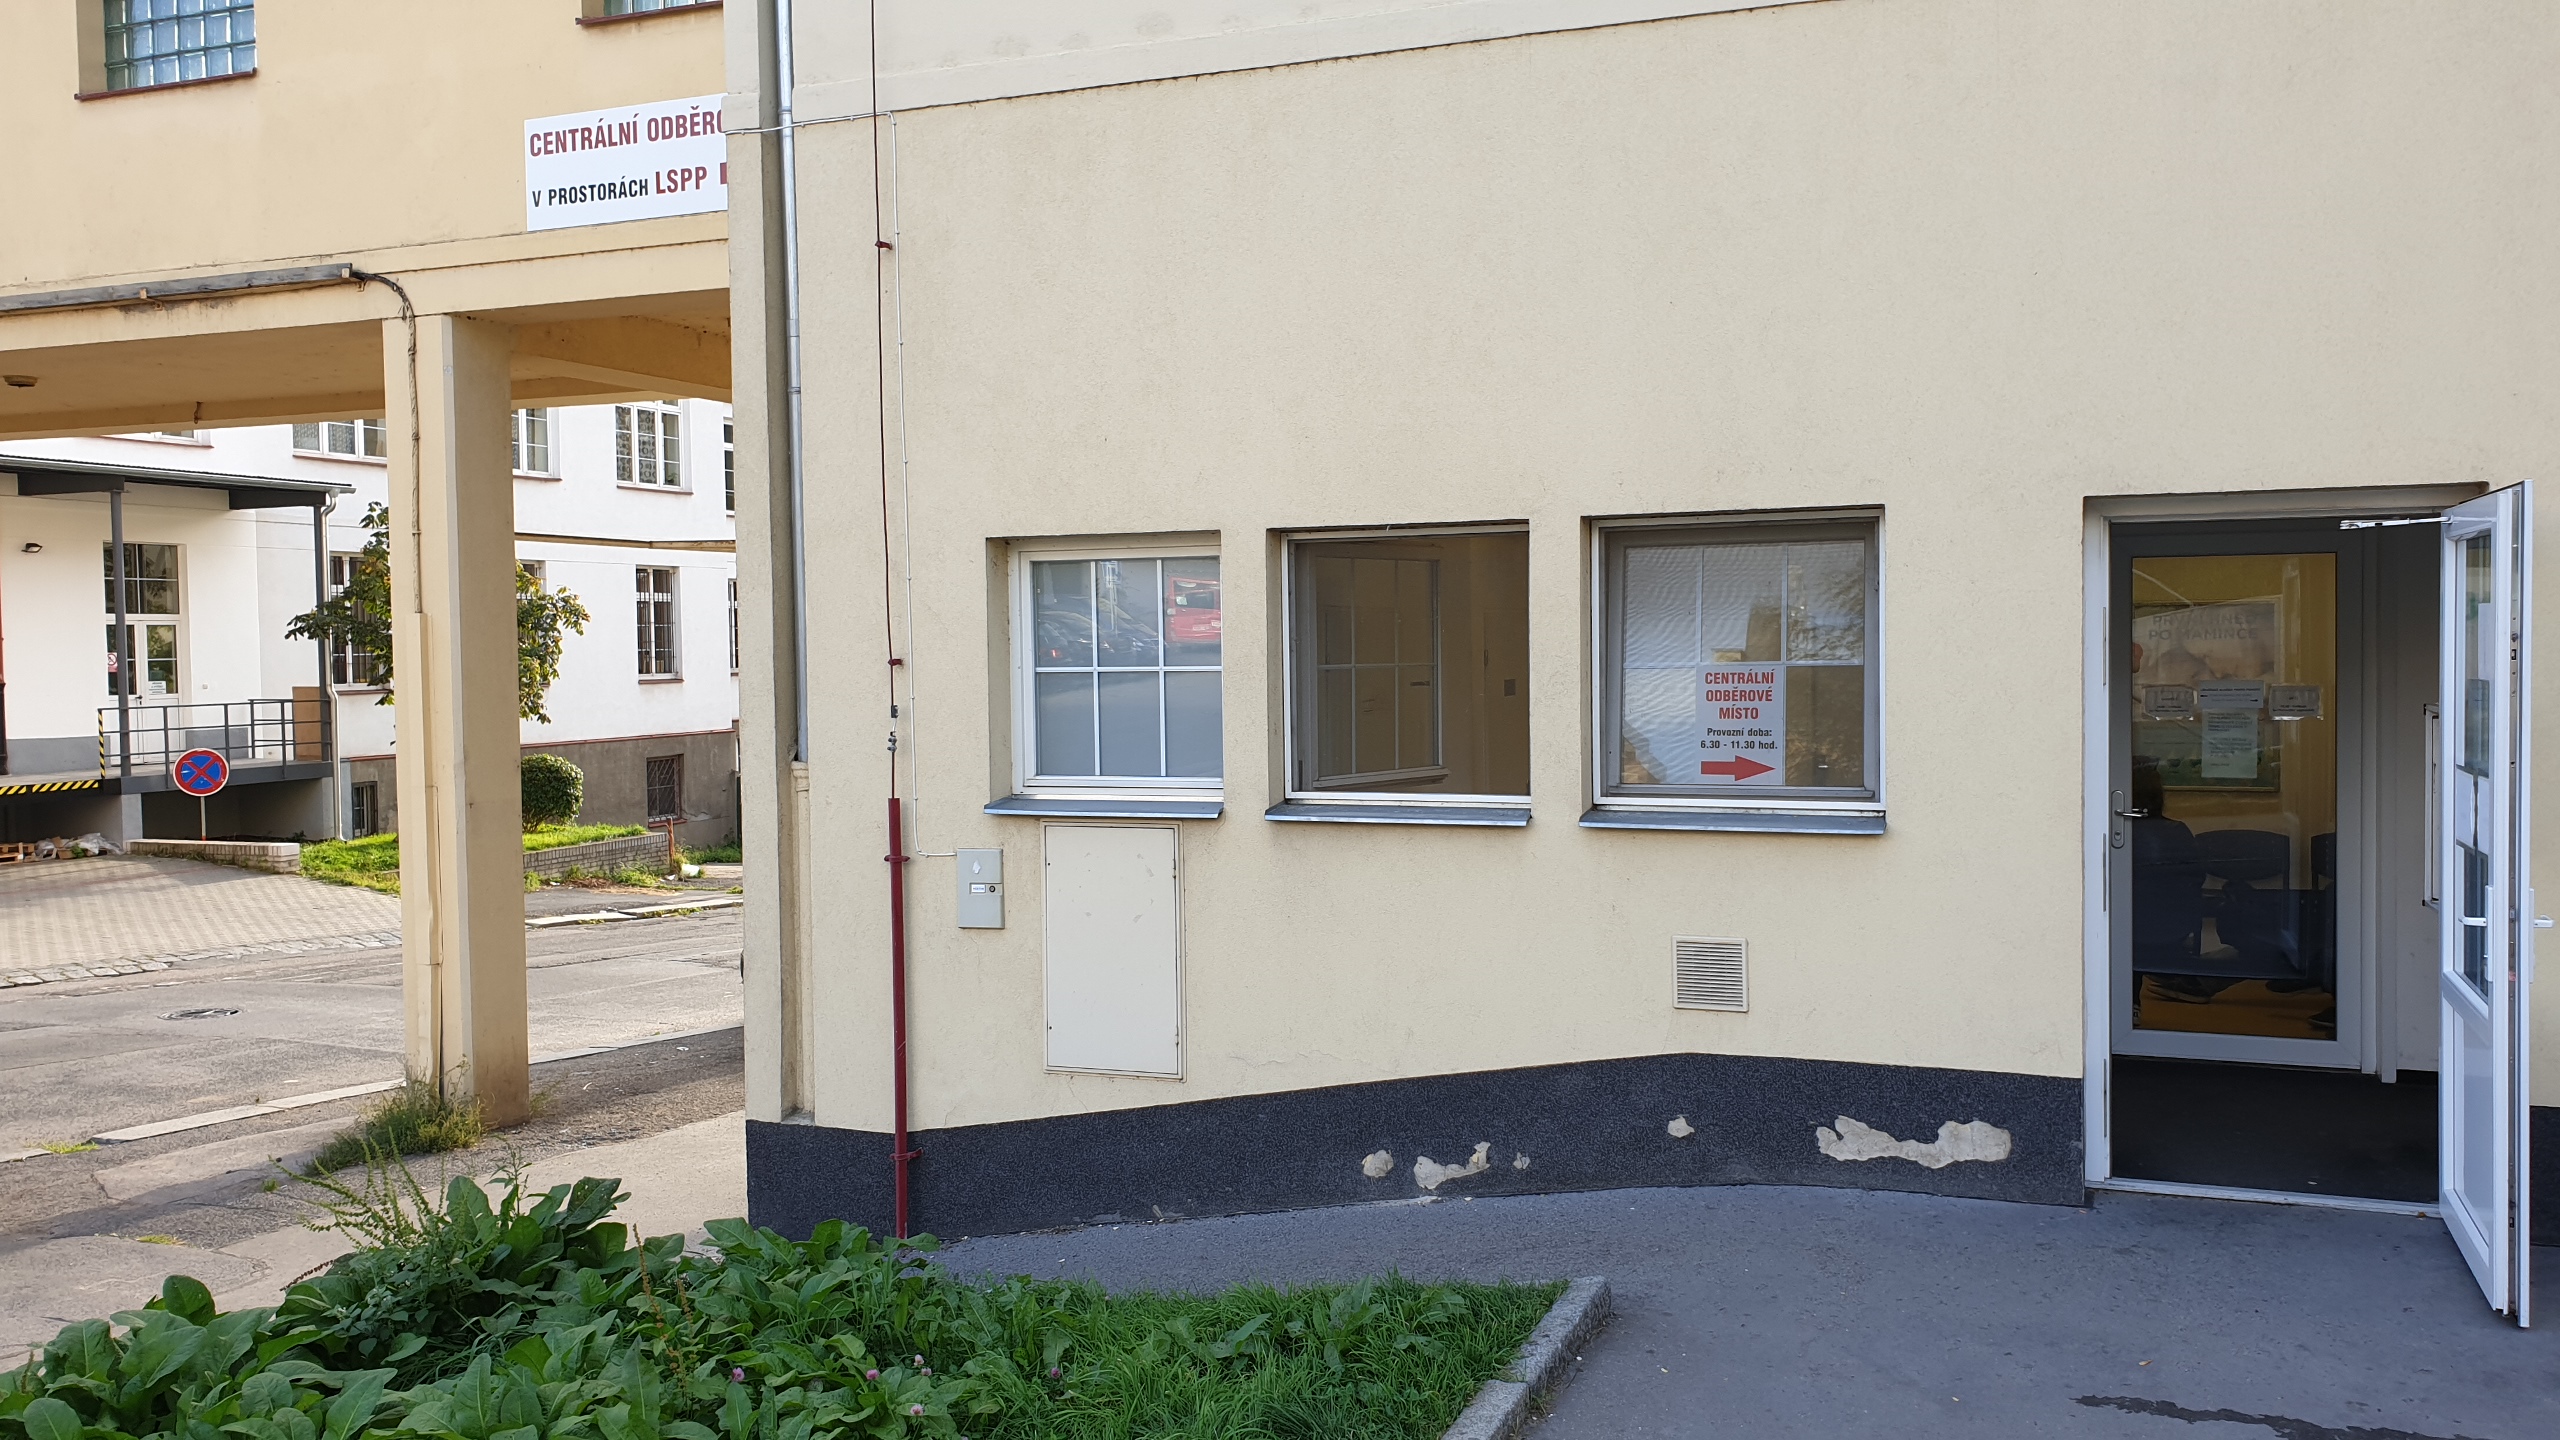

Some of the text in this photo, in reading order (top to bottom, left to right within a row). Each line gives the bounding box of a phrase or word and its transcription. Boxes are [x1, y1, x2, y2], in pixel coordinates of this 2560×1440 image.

[530, 113, 640, 157] CENTRÁLNÍ
[532, 190, 542, 208] V
[548, 175, 649, 206] PROSTORÁCH
[655, 166, 708, 195] LSPP
[1705, 669, 1775, 684] CENTRÁLNÍ
[1705, 686, 1773, 702] ODBĚROVÉ
[1718, 703, 1759, 720] MÍSTO
[1707, 728, 1772, 736] Provozní doba:
[1700, 740, 1720, 749] 6.30
[1731, 740, 1755, 749] 11.30
[1758, 740, 1778, 750] hod.
